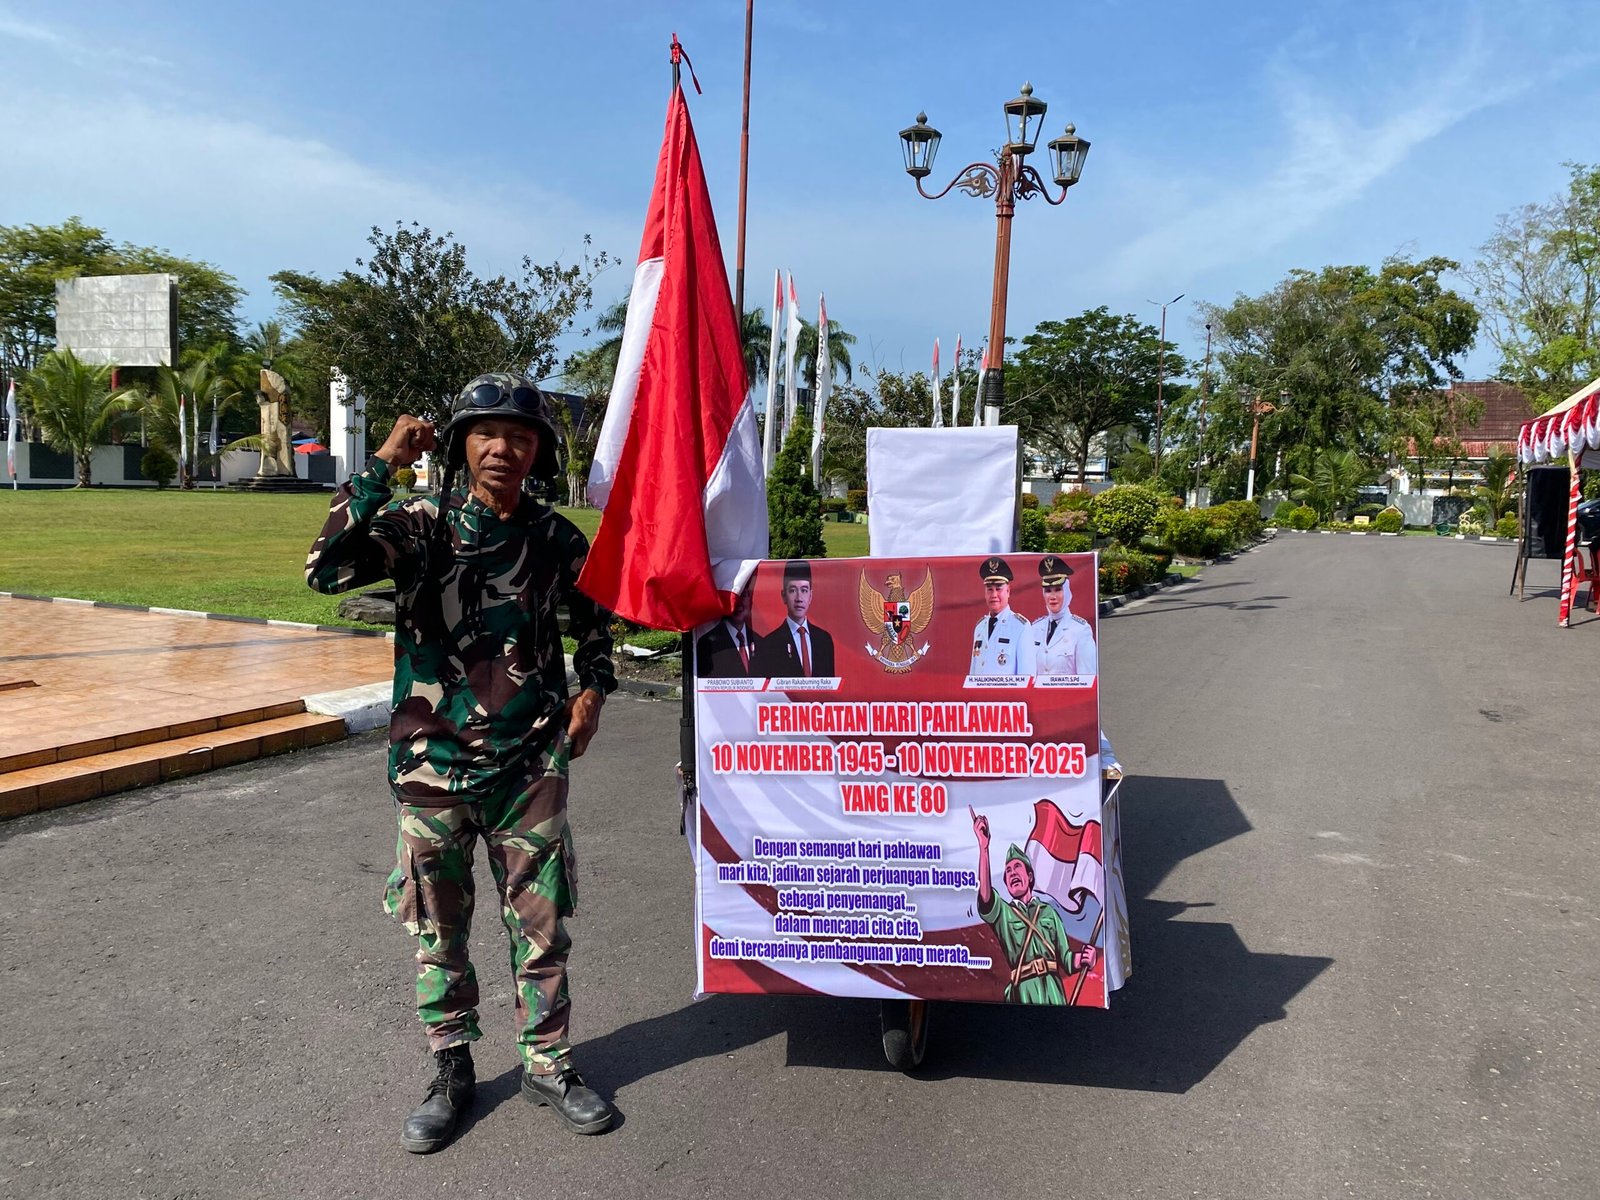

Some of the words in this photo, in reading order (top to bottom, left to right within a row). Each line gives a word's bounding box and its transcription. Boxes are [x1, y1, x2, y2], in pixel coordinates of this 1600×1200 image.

[758, 705, 868, 733] PERINGATAN
[872, 705, 916, 733] HARI
[921, 705, 1031, 733] PAHLAWAN.
[711, 744, 733, 772] 10
[737, 744, 833, 772] NOVEMBER
[836, 745, 884, 773] 1945
[897, 745, 921, 773] 10
[925, 745, 1028, 774] NOVEMBER
[1032, 746, 1085, 775] 2025
[841, 784, 890, 813] YANG
[893, 785, 916, 813] KE
[920, 785, 946, 814] 80
[754, 838, 797, 858] Dengan
[800, 841, 857, 859] semangat
[858, 841, 881, 859] hari
[884, 841, 941, 860] pahlawan
[719, 863, 745, 881] mari
[747, 864, 771, 883] kita,
[772, 864, 815, 883] jadikan
[817, 865, 860, 884] sejarah
[862, 867, 930, 887] perjuangan
[931, 867, 978, 888] bangsa,
[779, 890, 825, 909] sebagai
[775, 914, 810, 933] dalam
[813, 917, 869, 936] mencapai
[871, 917, 894, 936] cita
[896, 918, 922, 938] cita,
[711, 938, 739, 957] demi
[741, 941, 808, 960] tercapainya
[811, 942, 893, 962] pembangunan
[895, 946, 923, 964] yang
